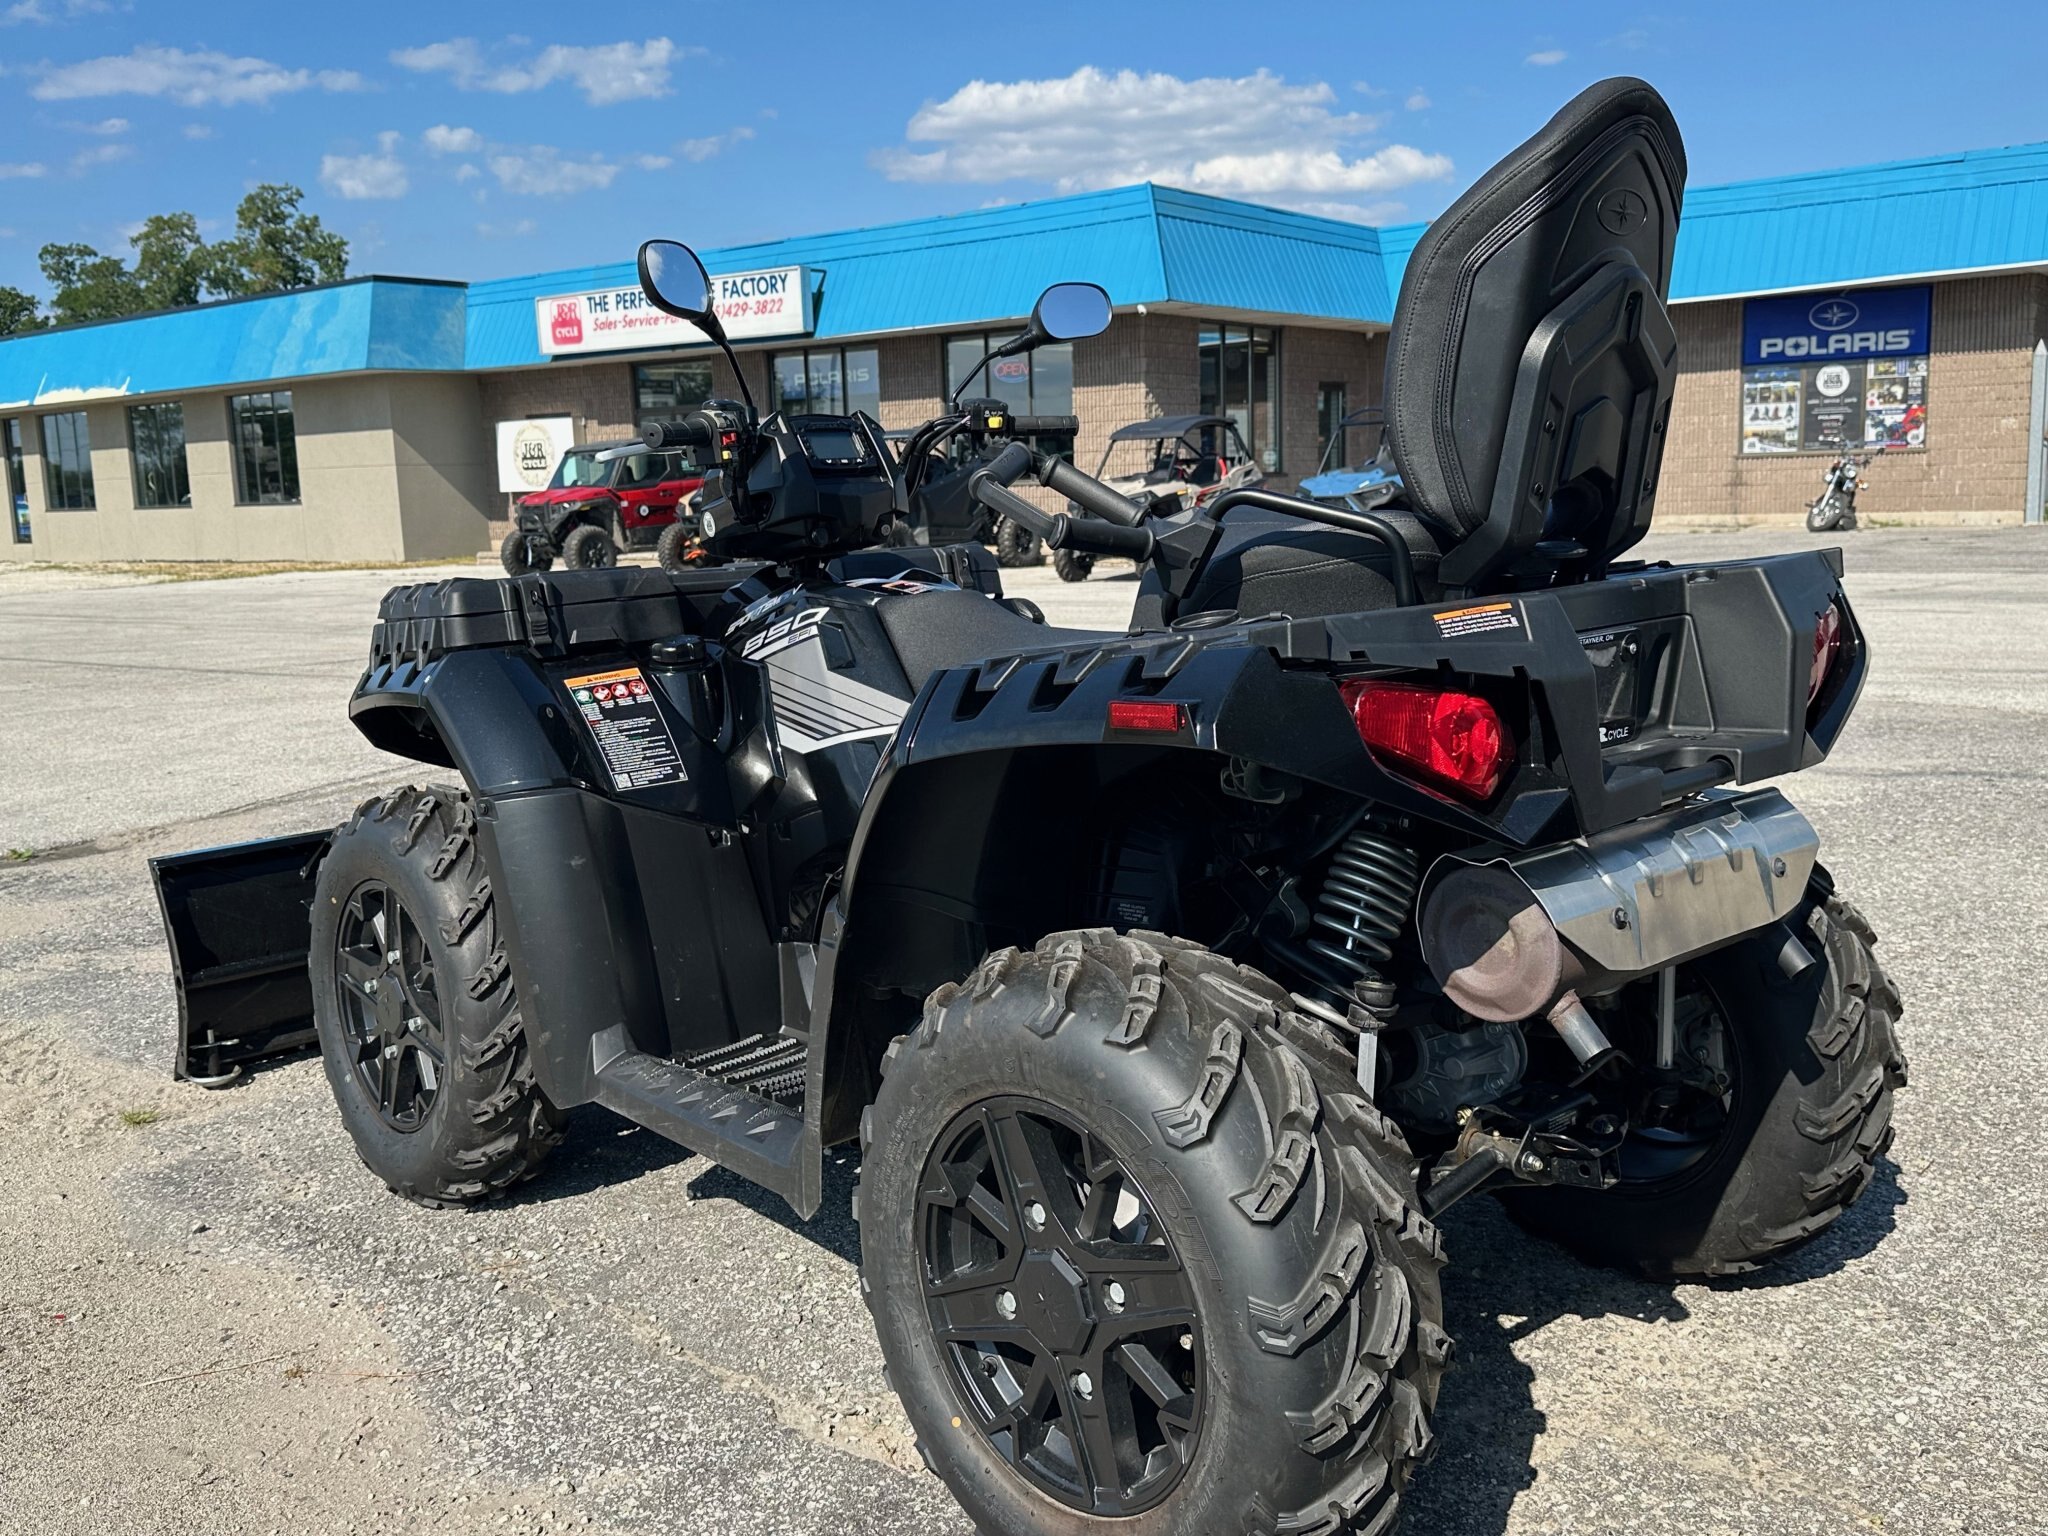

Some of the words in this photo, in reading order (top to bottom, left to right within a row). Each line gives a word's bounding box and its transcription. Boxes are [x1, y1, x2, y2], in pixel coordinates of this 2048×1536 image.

[587, 294, 610, 314] THE
[722, 273, 788, 301] FACTORY
[715, 297, 784, 320] 5)429-3822
[555, 325, 579, 339] CYCLE
[1759, 328, 1911, 359] POLARIS
[794, 367, 870, 387] POLARIS
[996, 361, 1030, 377] OPEN
[522, 442, 546, 458] J&R
[522, 459, 547, 469] CYCLE
[741, 606, 831, 658] 850
[787, 627, 812, 644] EFI
[1608, 726, 1630, 740] CYCLE
